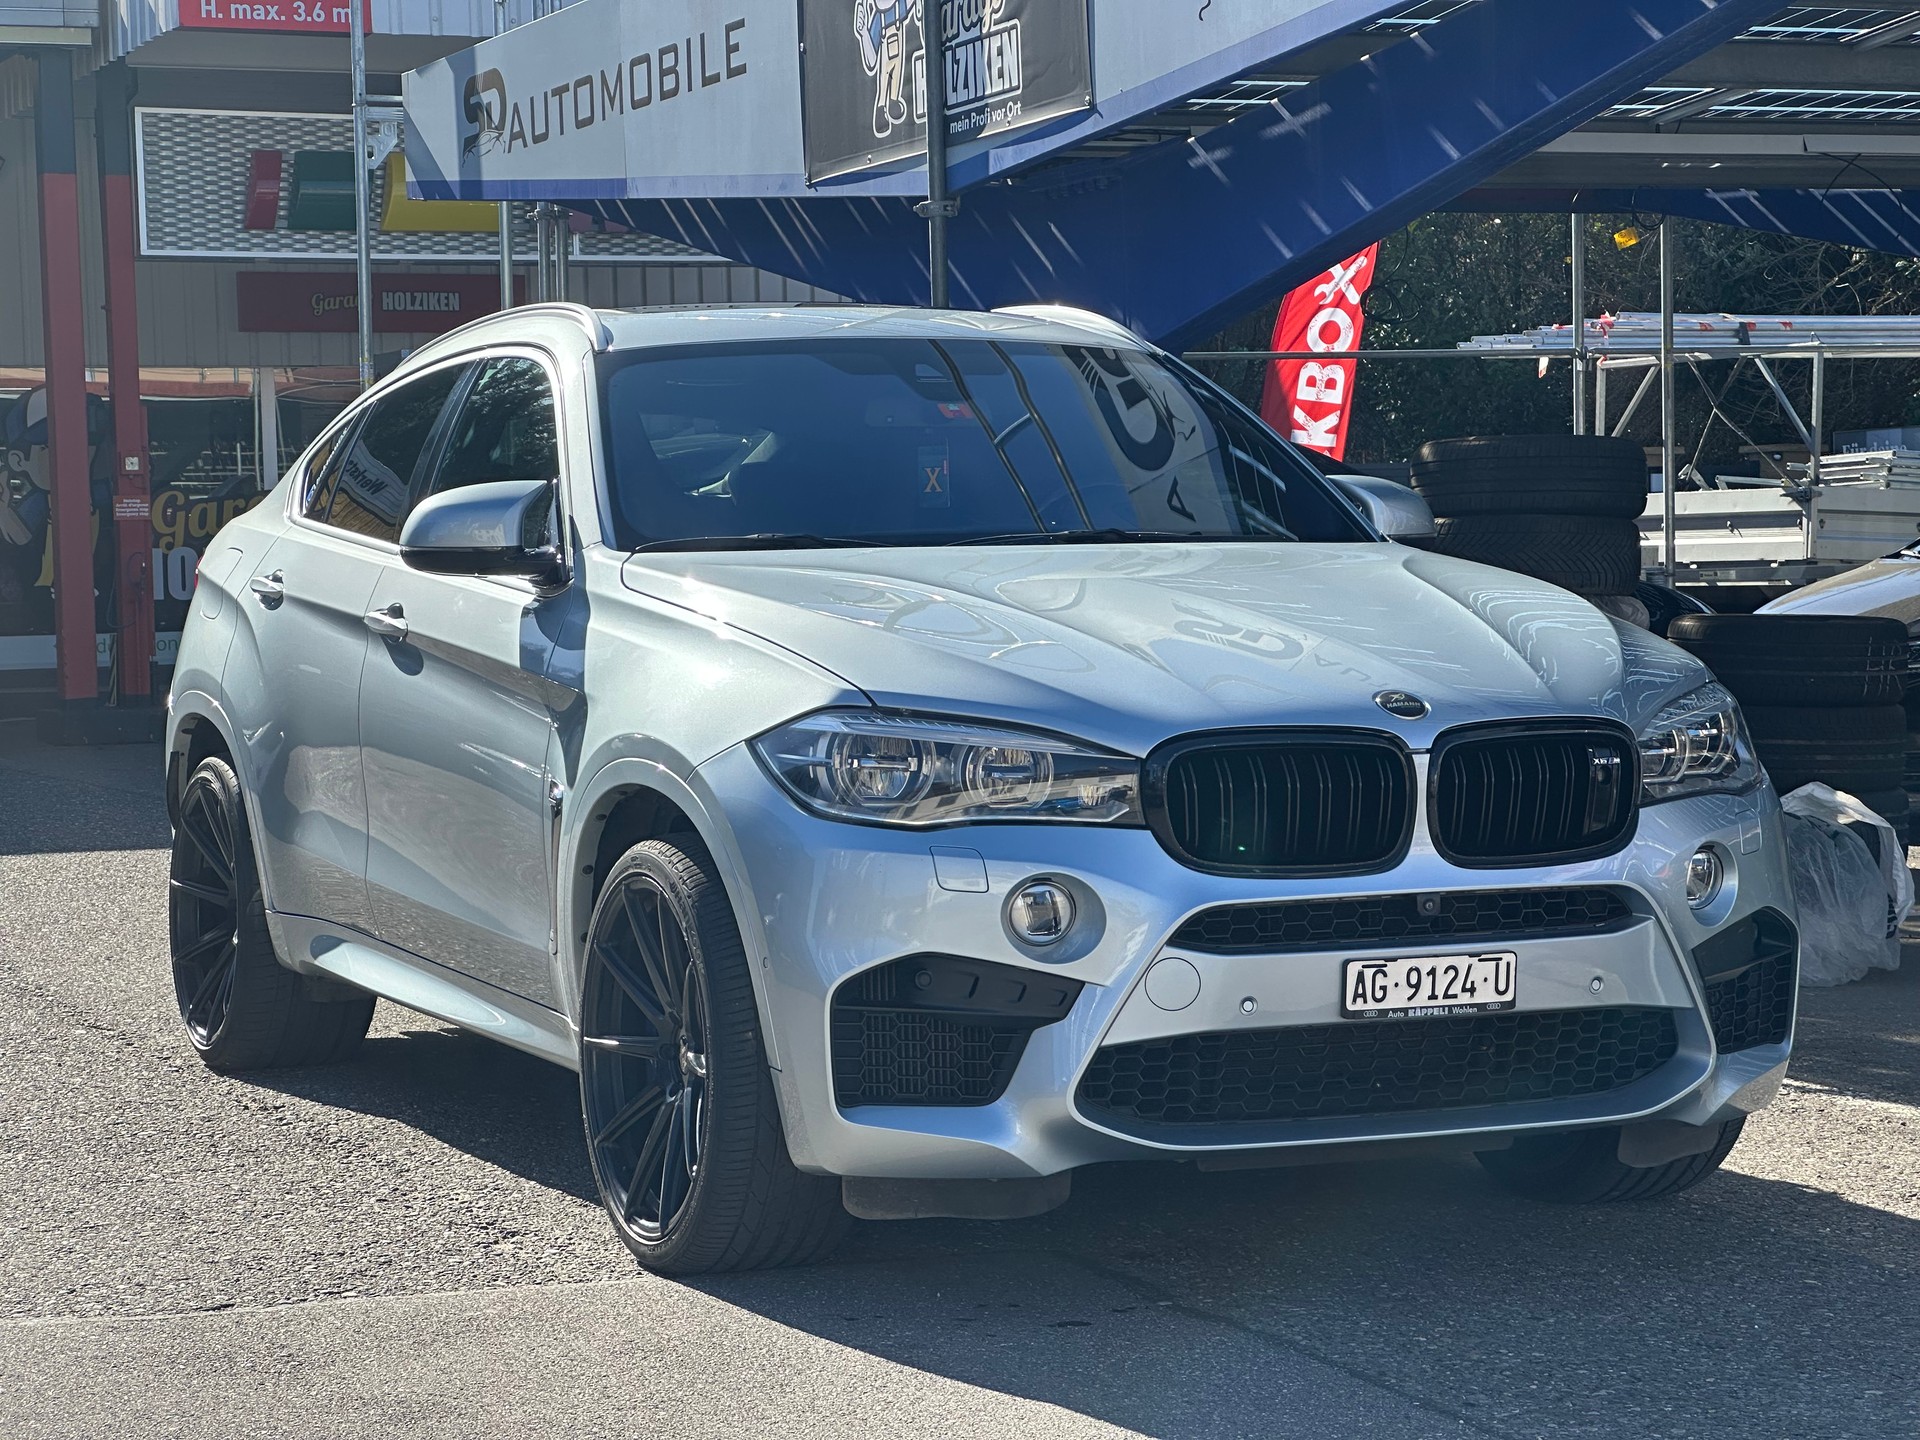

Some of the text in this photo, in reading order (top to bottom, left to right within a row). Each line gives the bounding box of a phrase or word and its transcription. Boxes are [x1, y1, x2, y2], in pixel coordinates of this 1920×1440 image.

[201, 0, 351, 23] H. max. 3.6 m
[507, 17, 748, 154] AUTOMOBILE
[915, 28, 1019, 115] HLZIKEN
[950, 101, 1022, 134] mein Profi vor Ort
[312, 291, 460, 317] Gara HOLZIKEN
[1290, 255, 1367, 457] KBOX
[152, 490, 264, 554] Gar
[1386, 701, 1421, 709] HAMANN
[1387, 1004, 1478, 1018] Auto KÄPPELI Wohlen
